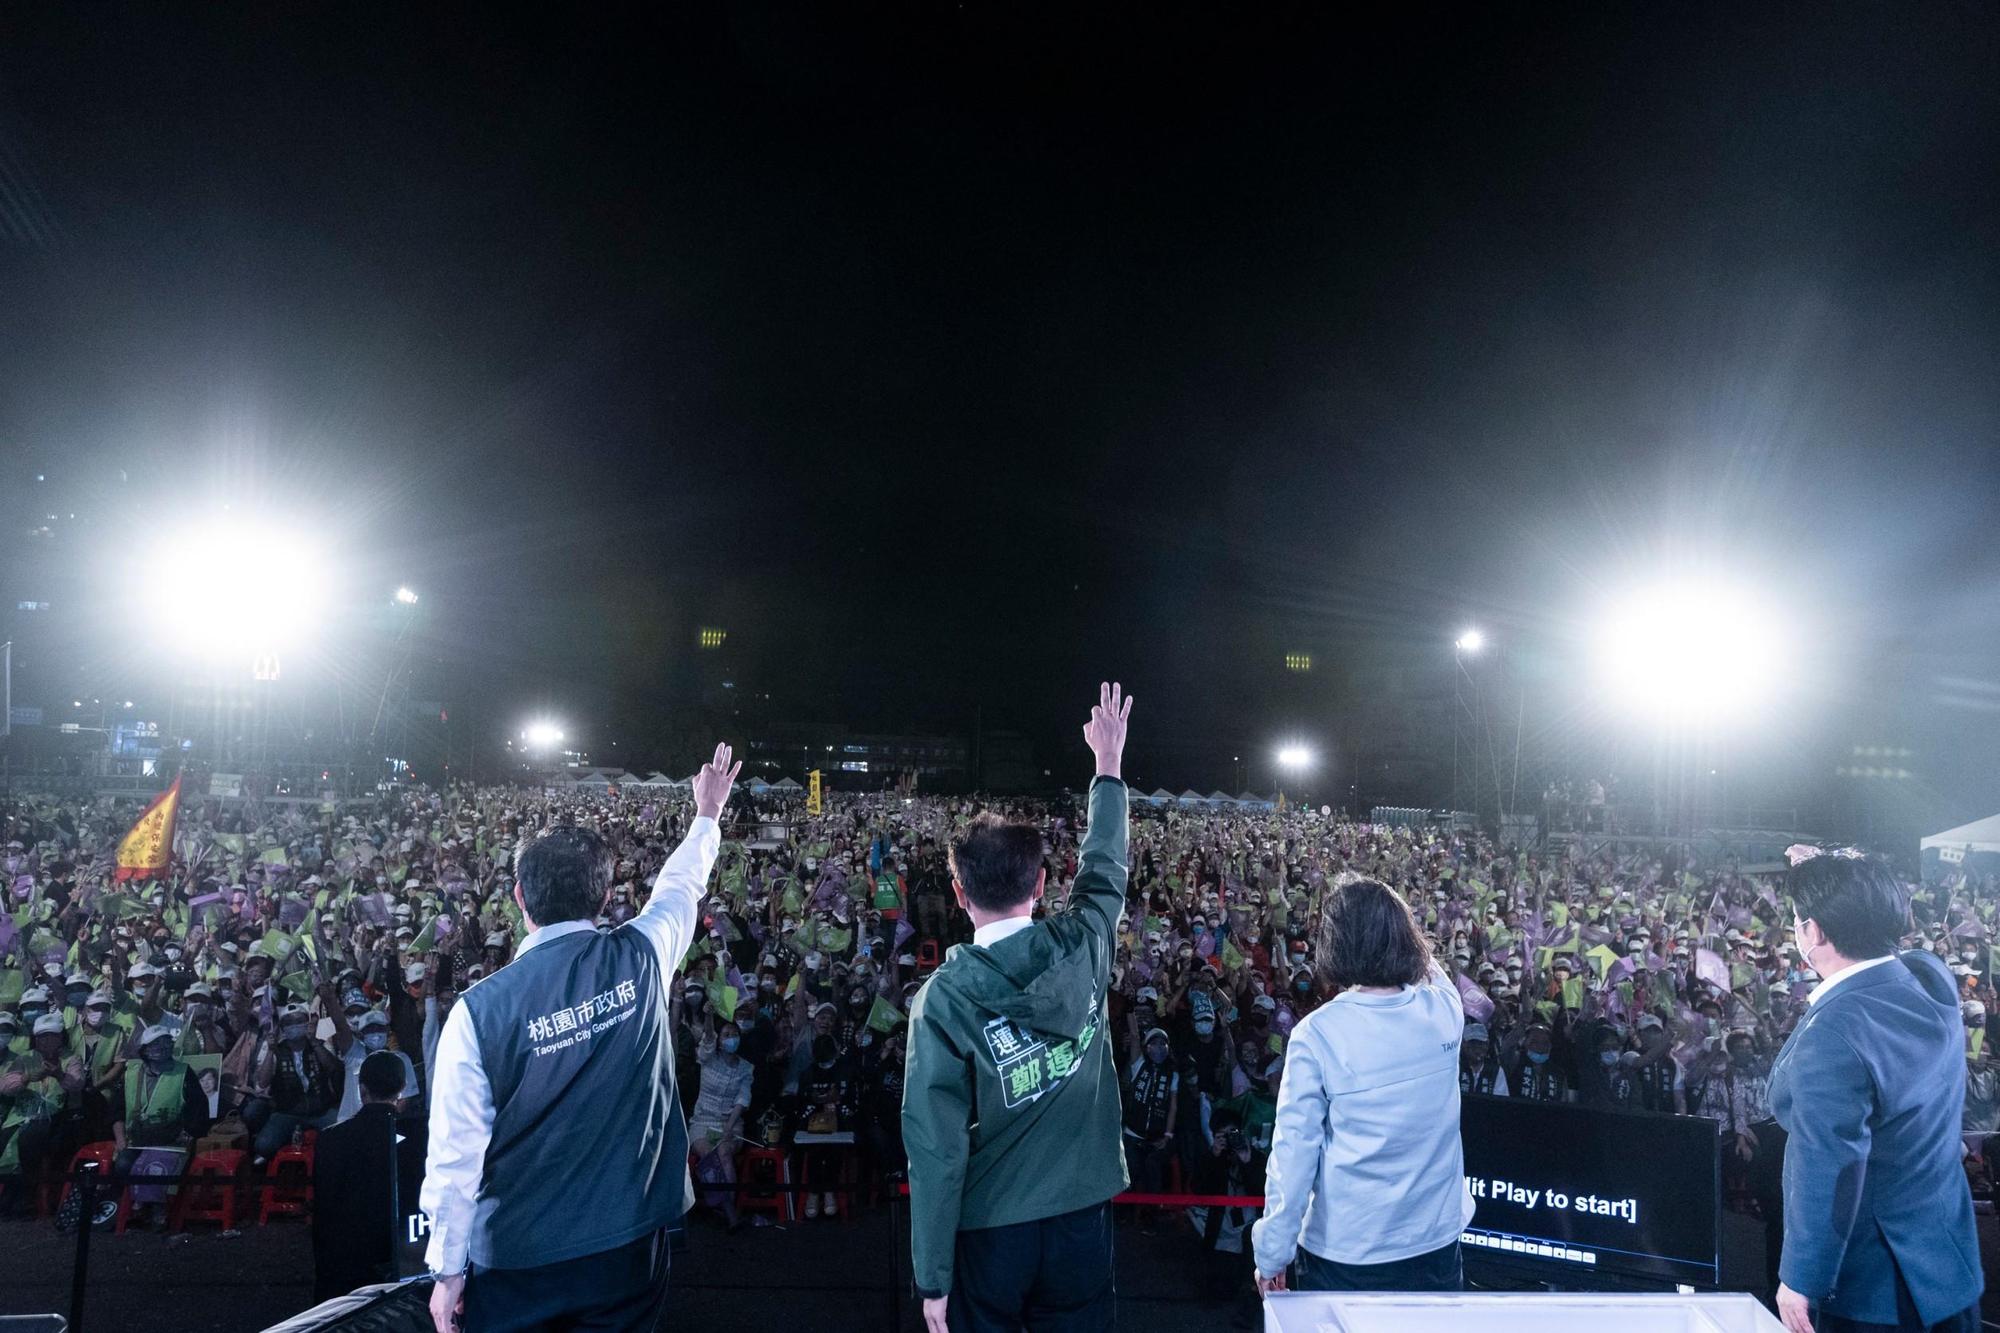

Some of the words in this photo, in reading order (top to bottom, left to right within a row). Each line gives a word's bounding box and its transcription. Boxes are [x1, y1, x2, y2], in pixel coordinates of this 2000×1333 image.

[527, 979, 636, 1042] 桃園市政府
[533, 1037, 574, 1057] Taoyuan
[575, 1029, 592, 1042] City
[592, 1003, 637, 1034] Government
[991, 1024, 1031, 1057] 運
[1465, 1176, 1486, 1197] it
[1492, 1180, 1540, 1209] Play
[1545, 1189, 1569, 1209] to
[1574, 1194, 1637, 1224] start]
